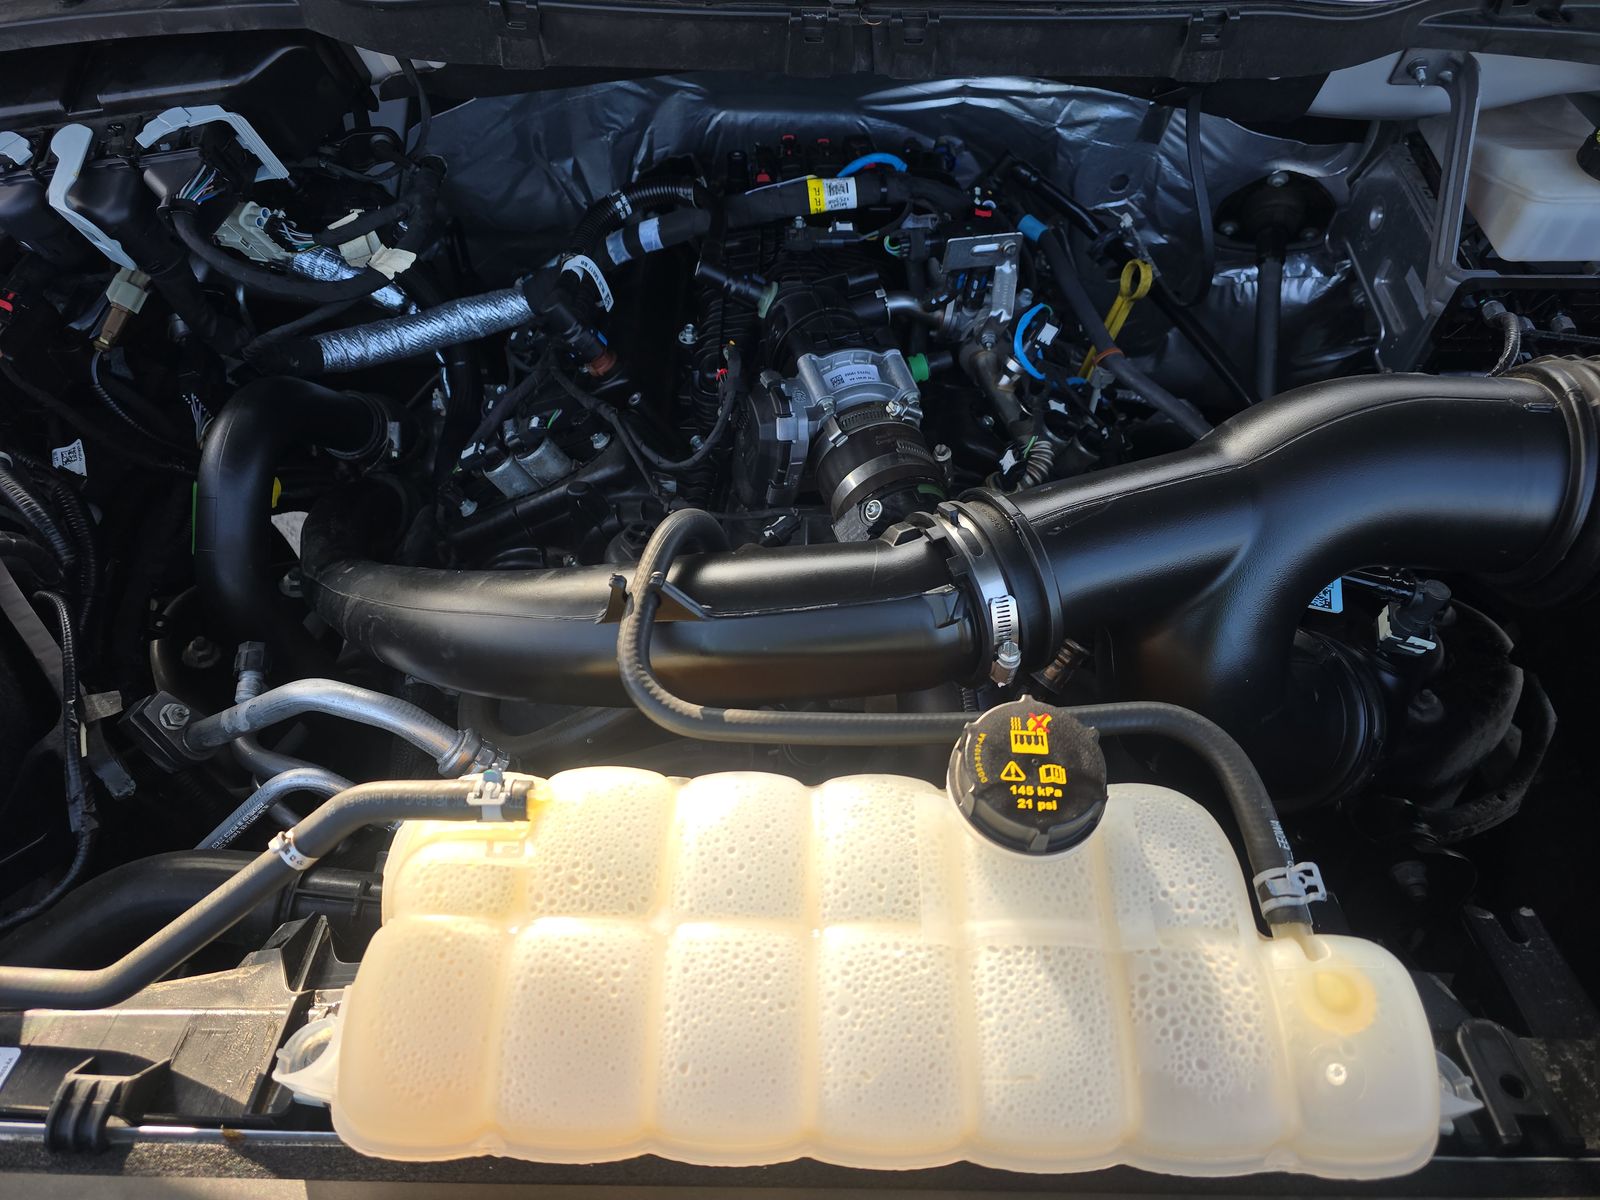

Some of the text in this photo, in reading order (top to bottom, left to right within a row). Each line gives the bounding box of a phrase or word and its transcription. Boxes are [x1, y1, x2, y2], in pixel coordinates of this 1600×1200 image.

[1009, 785, 1063, 797] 145 kPa
[1017, 799, 1058, 812] 21 psi
